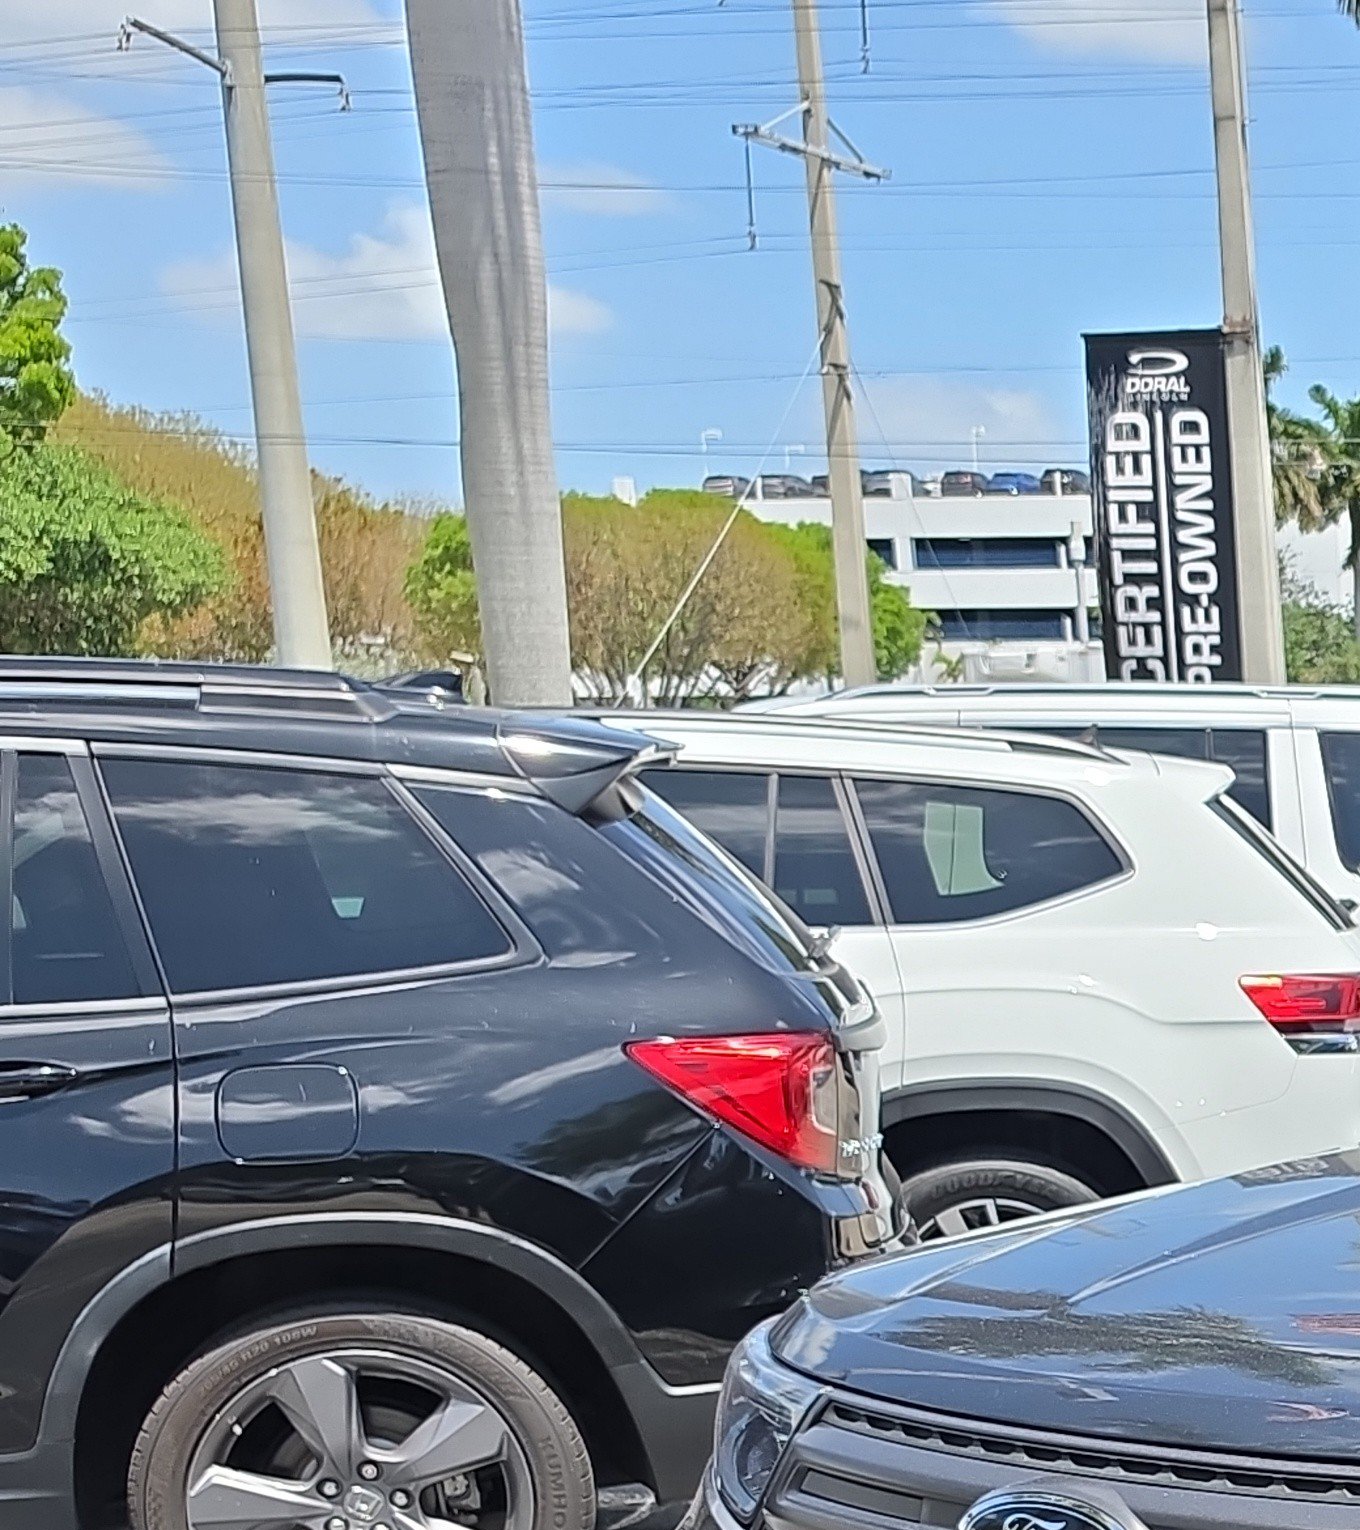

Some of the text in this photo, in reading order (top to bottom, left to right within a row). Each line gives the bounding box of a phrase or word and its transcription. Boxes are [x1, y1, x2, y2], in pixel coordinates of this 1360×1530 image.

[1126, 376, 1190, 393] DORAL
[1105, 411, 1166, 683] CERTIFIED
[538, 1437, 568, 1529] KUMHO
